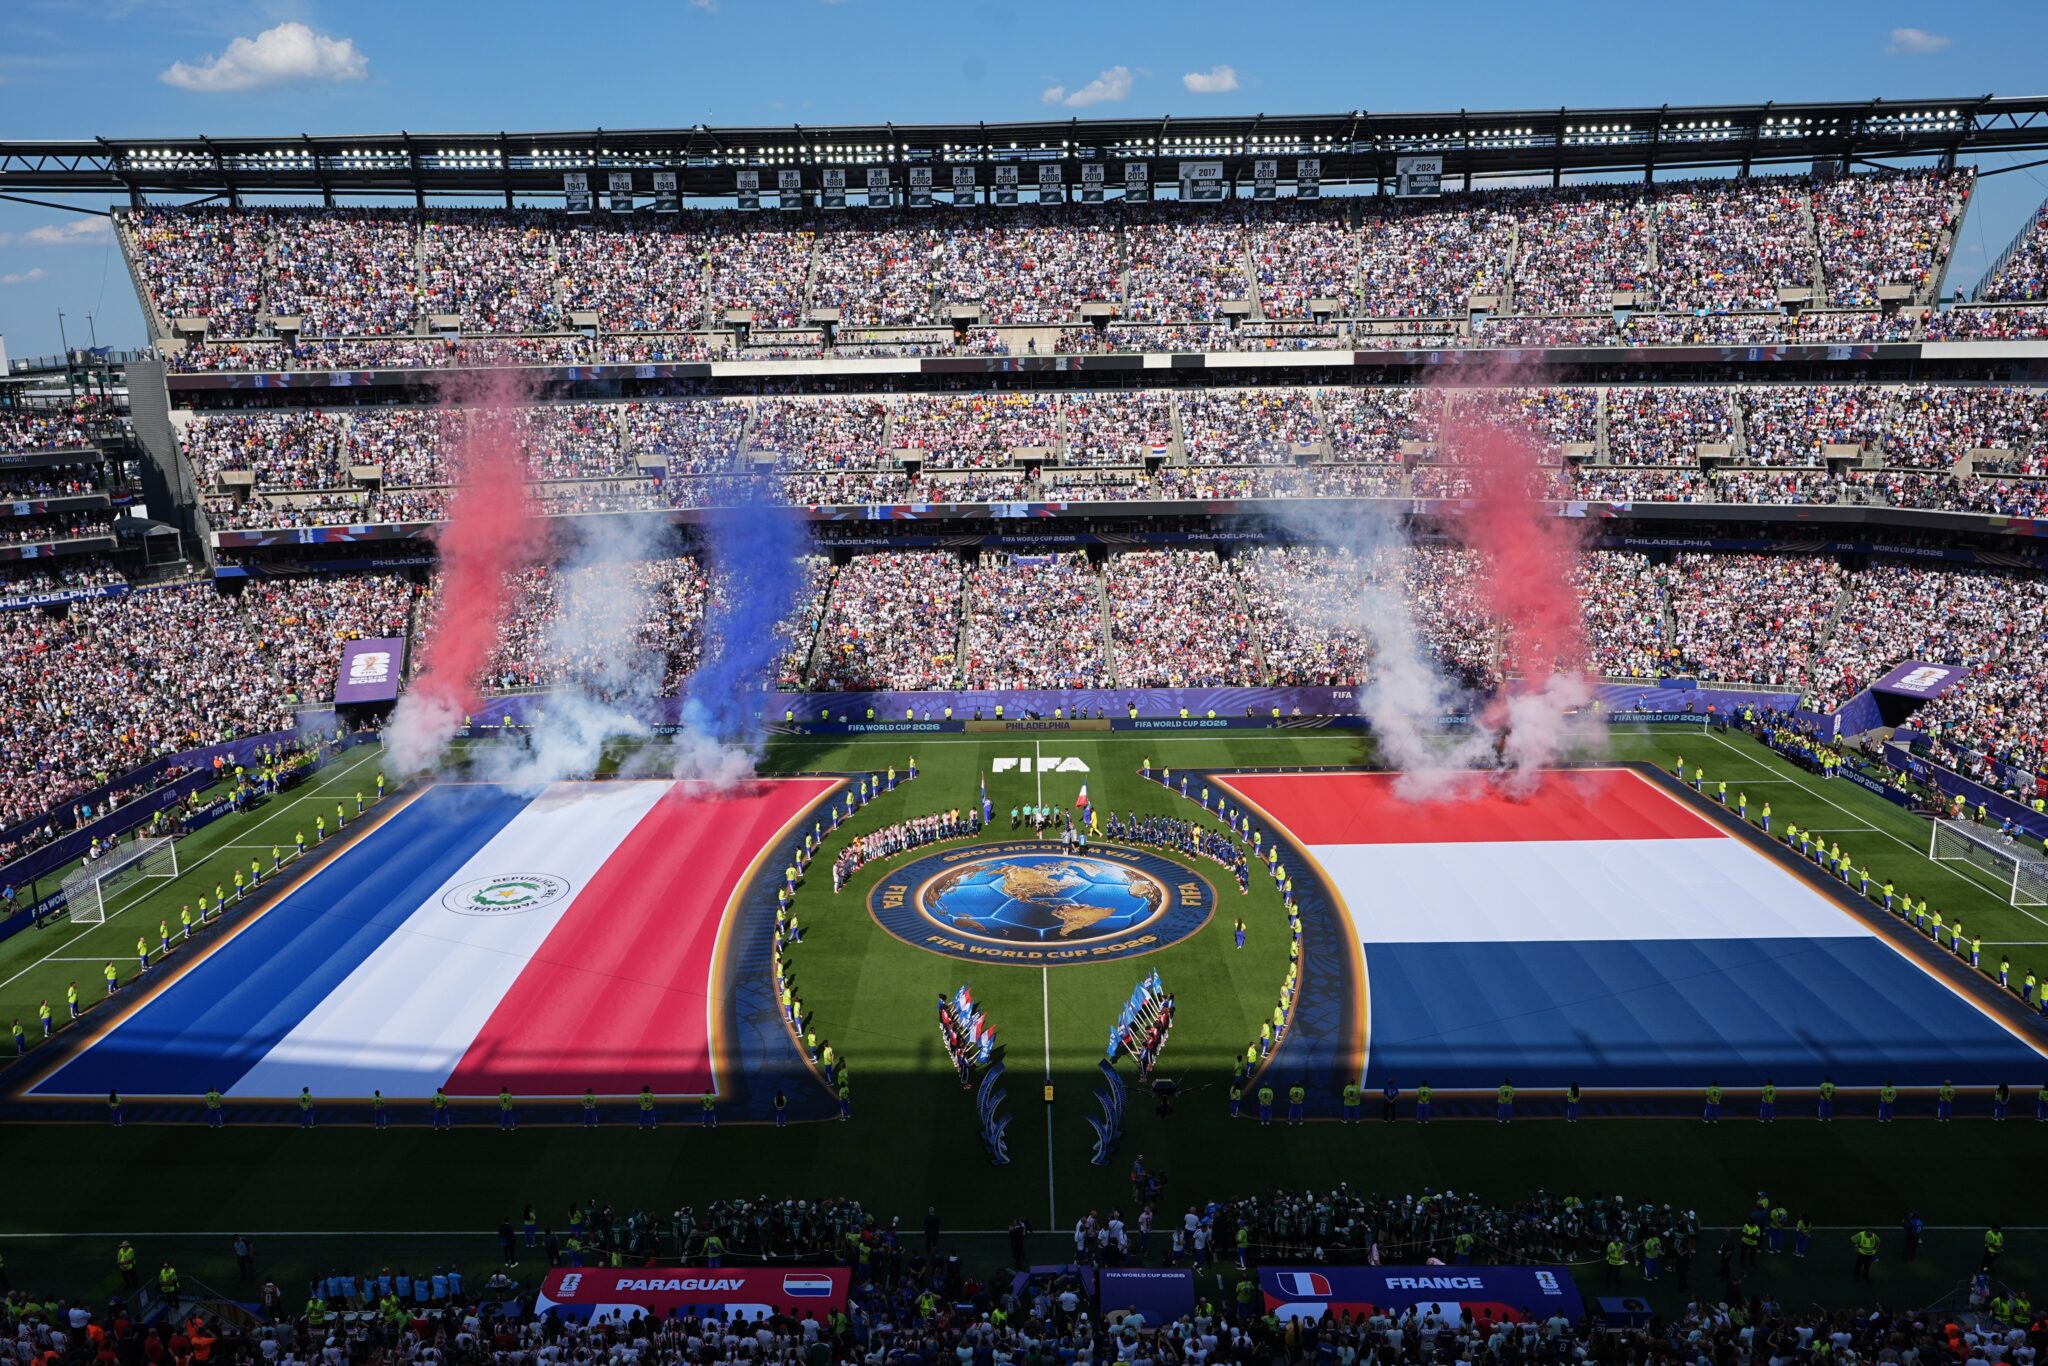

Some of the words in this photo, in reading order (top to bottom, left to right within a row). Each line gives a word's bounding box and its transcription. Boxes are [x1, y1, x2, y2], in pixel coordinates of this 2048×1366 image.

[612, 182, 630, 190] 1948
[657, 181, 674, 189] 1949
[0, 587, 107, 608] HILADELPHIA
[992, 757, 1090, 772] FIFA
[1854, 774, 1865, 784] CUP
[1865, 779, 1884, 794] 2026
[163, 789, 177, 801] FIFA
[212, 807, 224, 817] FIFA
[943, 847, 1000, 862] 2026
[1105, 850, 1142, 861] FIFA
[883, 885, 907, 909] FIFA
[1178, 882, 1201, 907] FIFA
[32, 904, 48, 918] FFA
[466, 900, 538, 911] PARAGUAY
[926, 935, 965, 950] FIFA
[969, 945, 1042, 959] WORLD
[1047, 950, 1088, 958] CUP
[1092, 934, 1158, 955] 2026
[616, 1279, 746, 1291] PARAGUAY
[1385, 1277, 1484, 1289] FRANCE
[1560, 1342, 1566, 1352] 8
